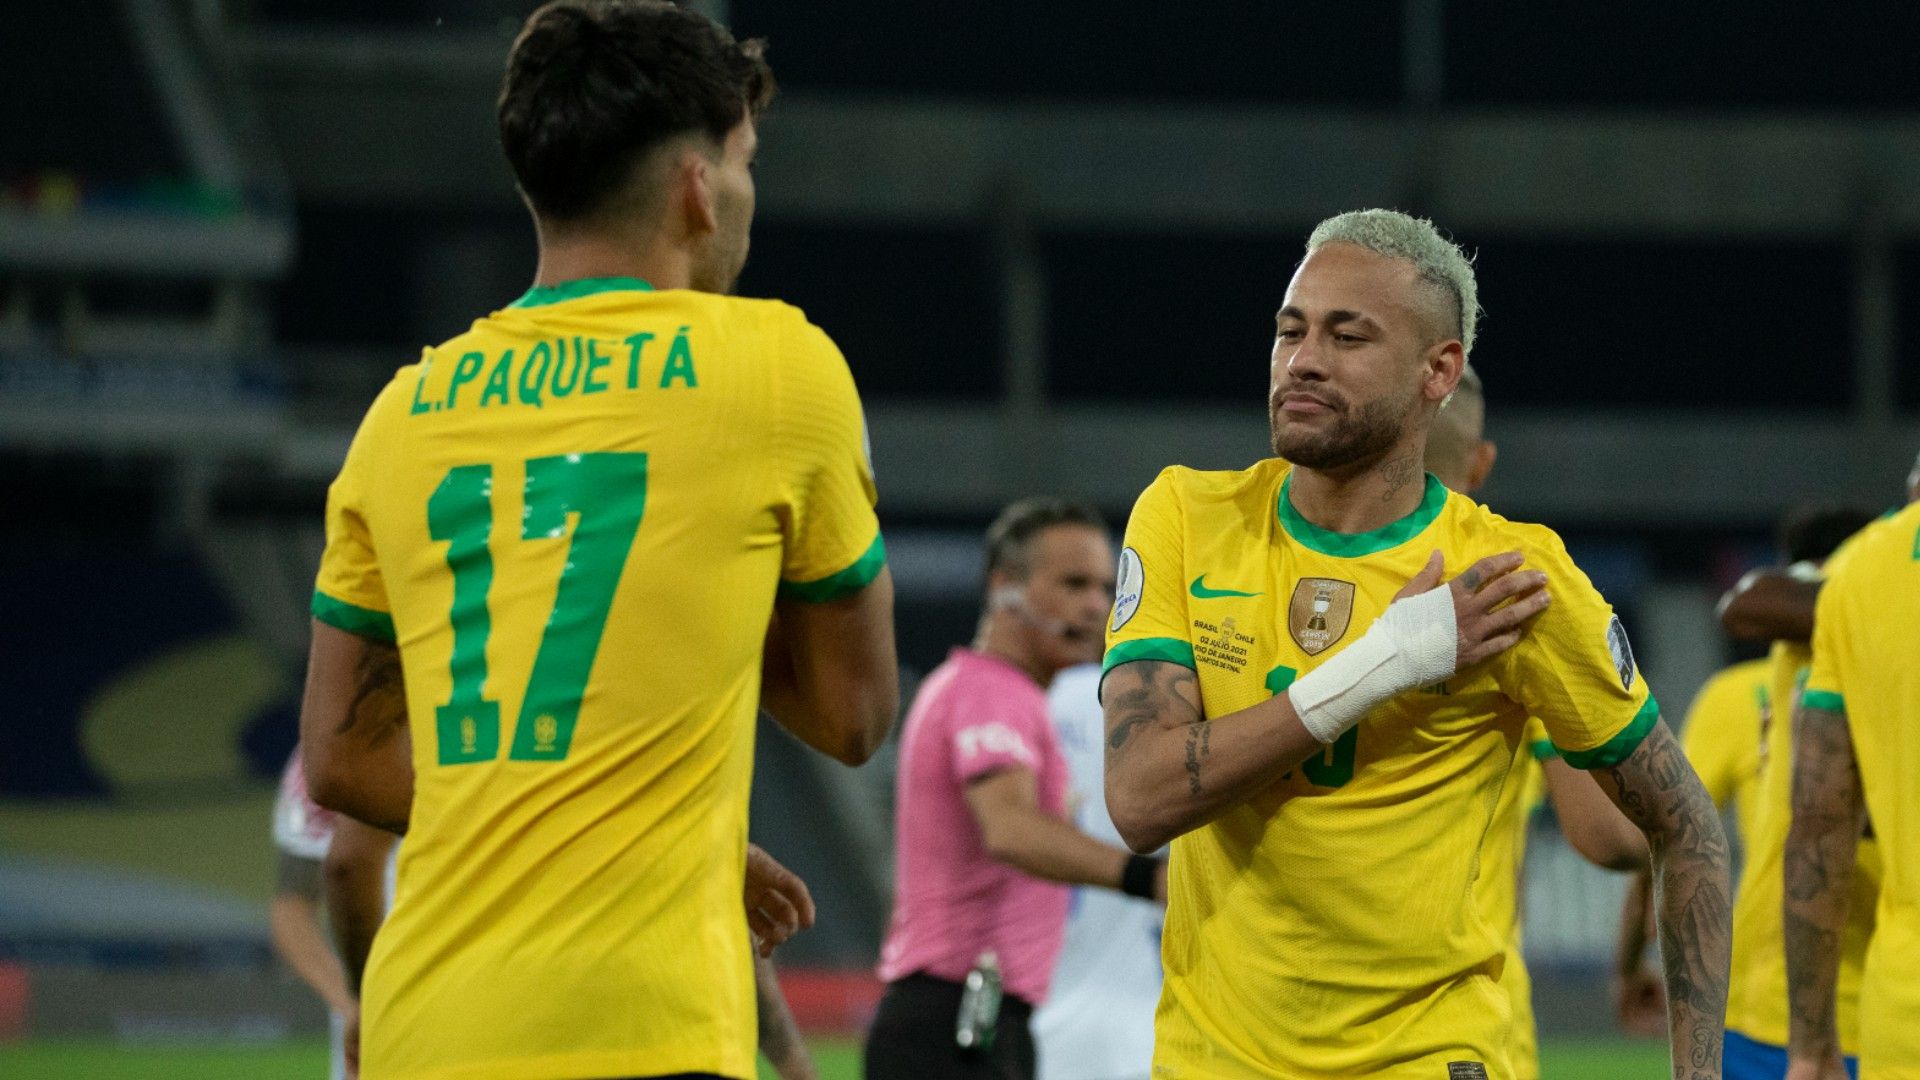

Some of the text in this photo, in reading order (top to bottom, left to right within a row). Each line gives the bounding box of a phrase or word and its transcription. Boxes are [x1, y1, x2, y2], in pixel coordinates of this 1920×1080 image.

[410, 326, 697, 415] L.PAQUETÁ
[427, 452, 648, 766] 17
[1194, 620, 1218, 633] BRASIL
[1235, 633, 1255, 645] CHILE
[1195, 645, 1247, 666] RIO DE JANEIRO
[1200, 636, 1247, 656] 02 JULIO 2021
